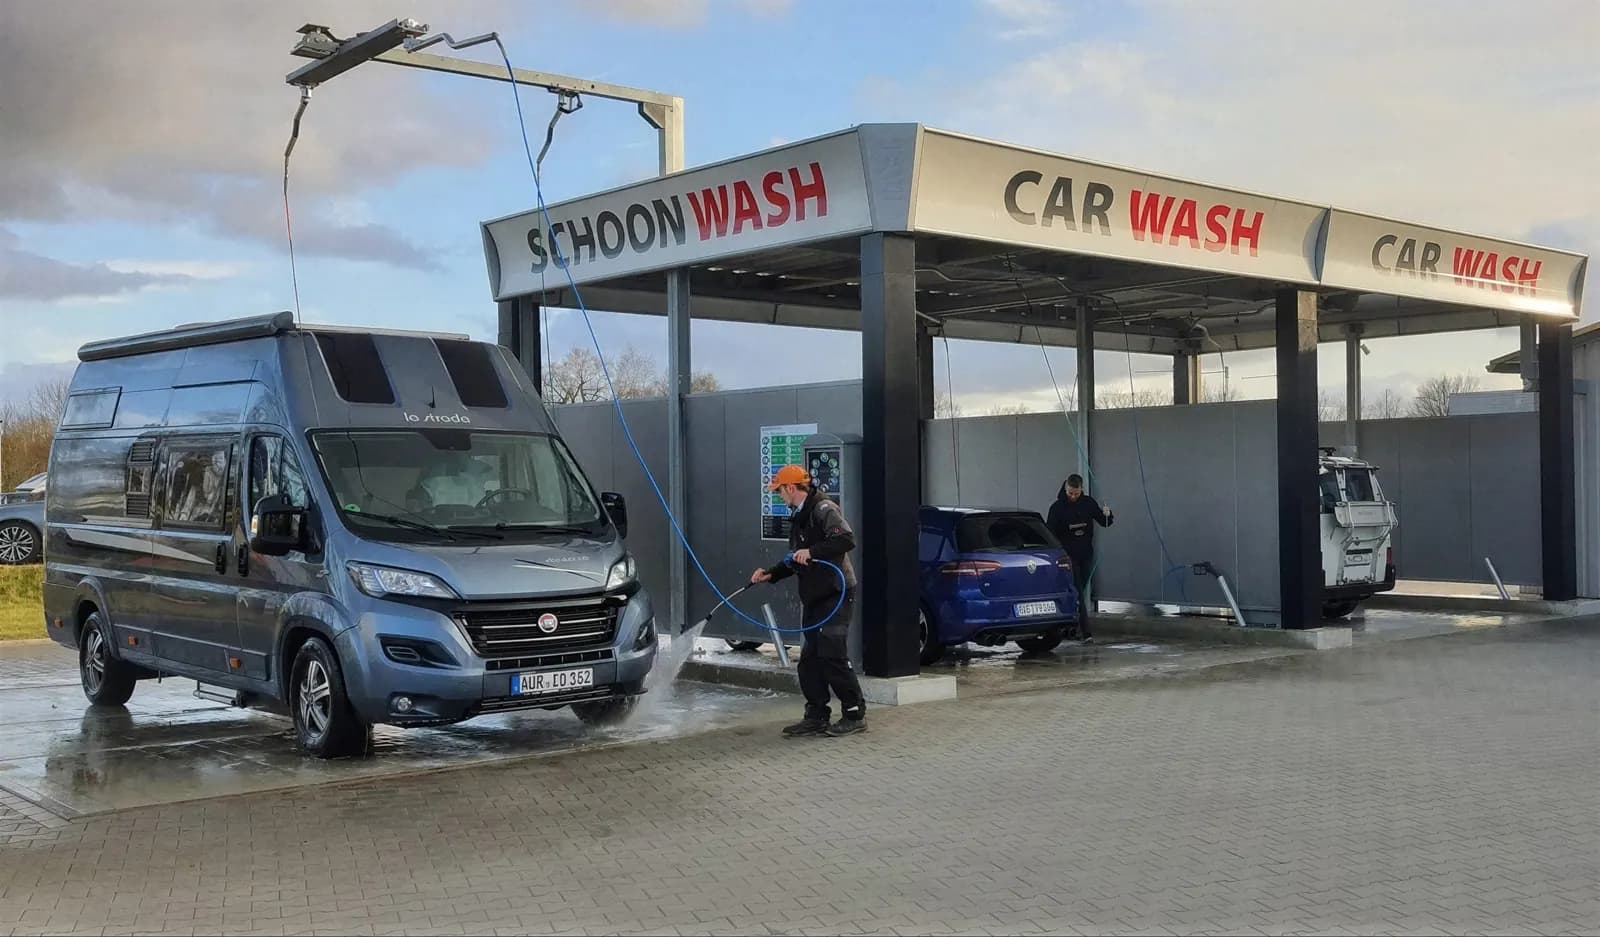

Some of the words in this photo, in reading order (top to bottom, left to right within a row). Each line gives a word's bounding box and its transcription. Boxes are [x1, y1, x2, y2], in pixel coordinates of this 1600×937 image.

[1004, 169, 1114, 237] CAR
[1130, 189, 1265, 257] WASH
[1371, 234, 1442, 281] CAR
[1453, 246, 1543, 297] WASH
